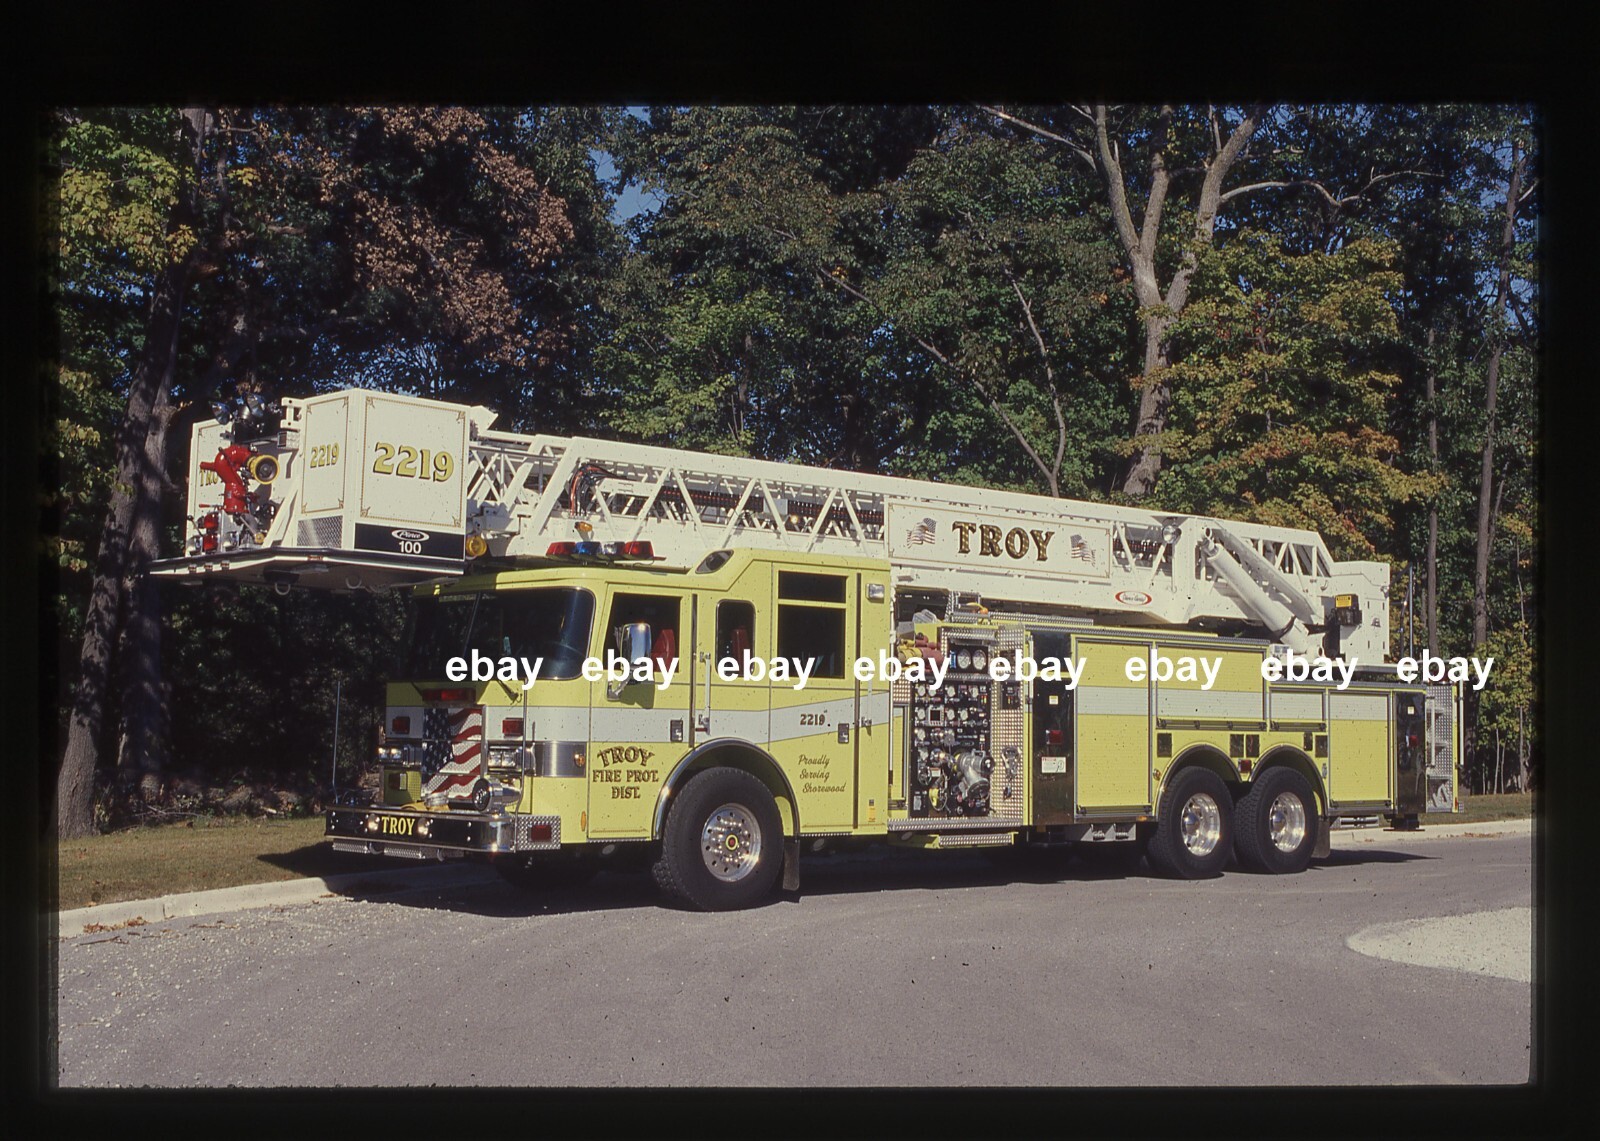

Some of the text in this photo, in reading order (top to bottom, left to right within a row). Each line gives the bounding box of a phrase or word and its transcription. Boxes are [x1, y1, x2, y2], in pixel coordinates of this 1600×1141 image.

[309, 442, 340, 468] 2219
[373, 442, 455, 482] 2219
[399, 541, 422, 554] 100
[952, 521, 1055, 562] TROY
[800, 714, 826, 726] 2219
[597, 746, 655, 768] TROY
[798, 754, 831, 769] Proudly
[592, 770, 622, 783] FIRE
[799, 769, 830, 783] Serving
[802, 782, 847, 794] Shorewood
[381, 816, 416, 836] TROY
